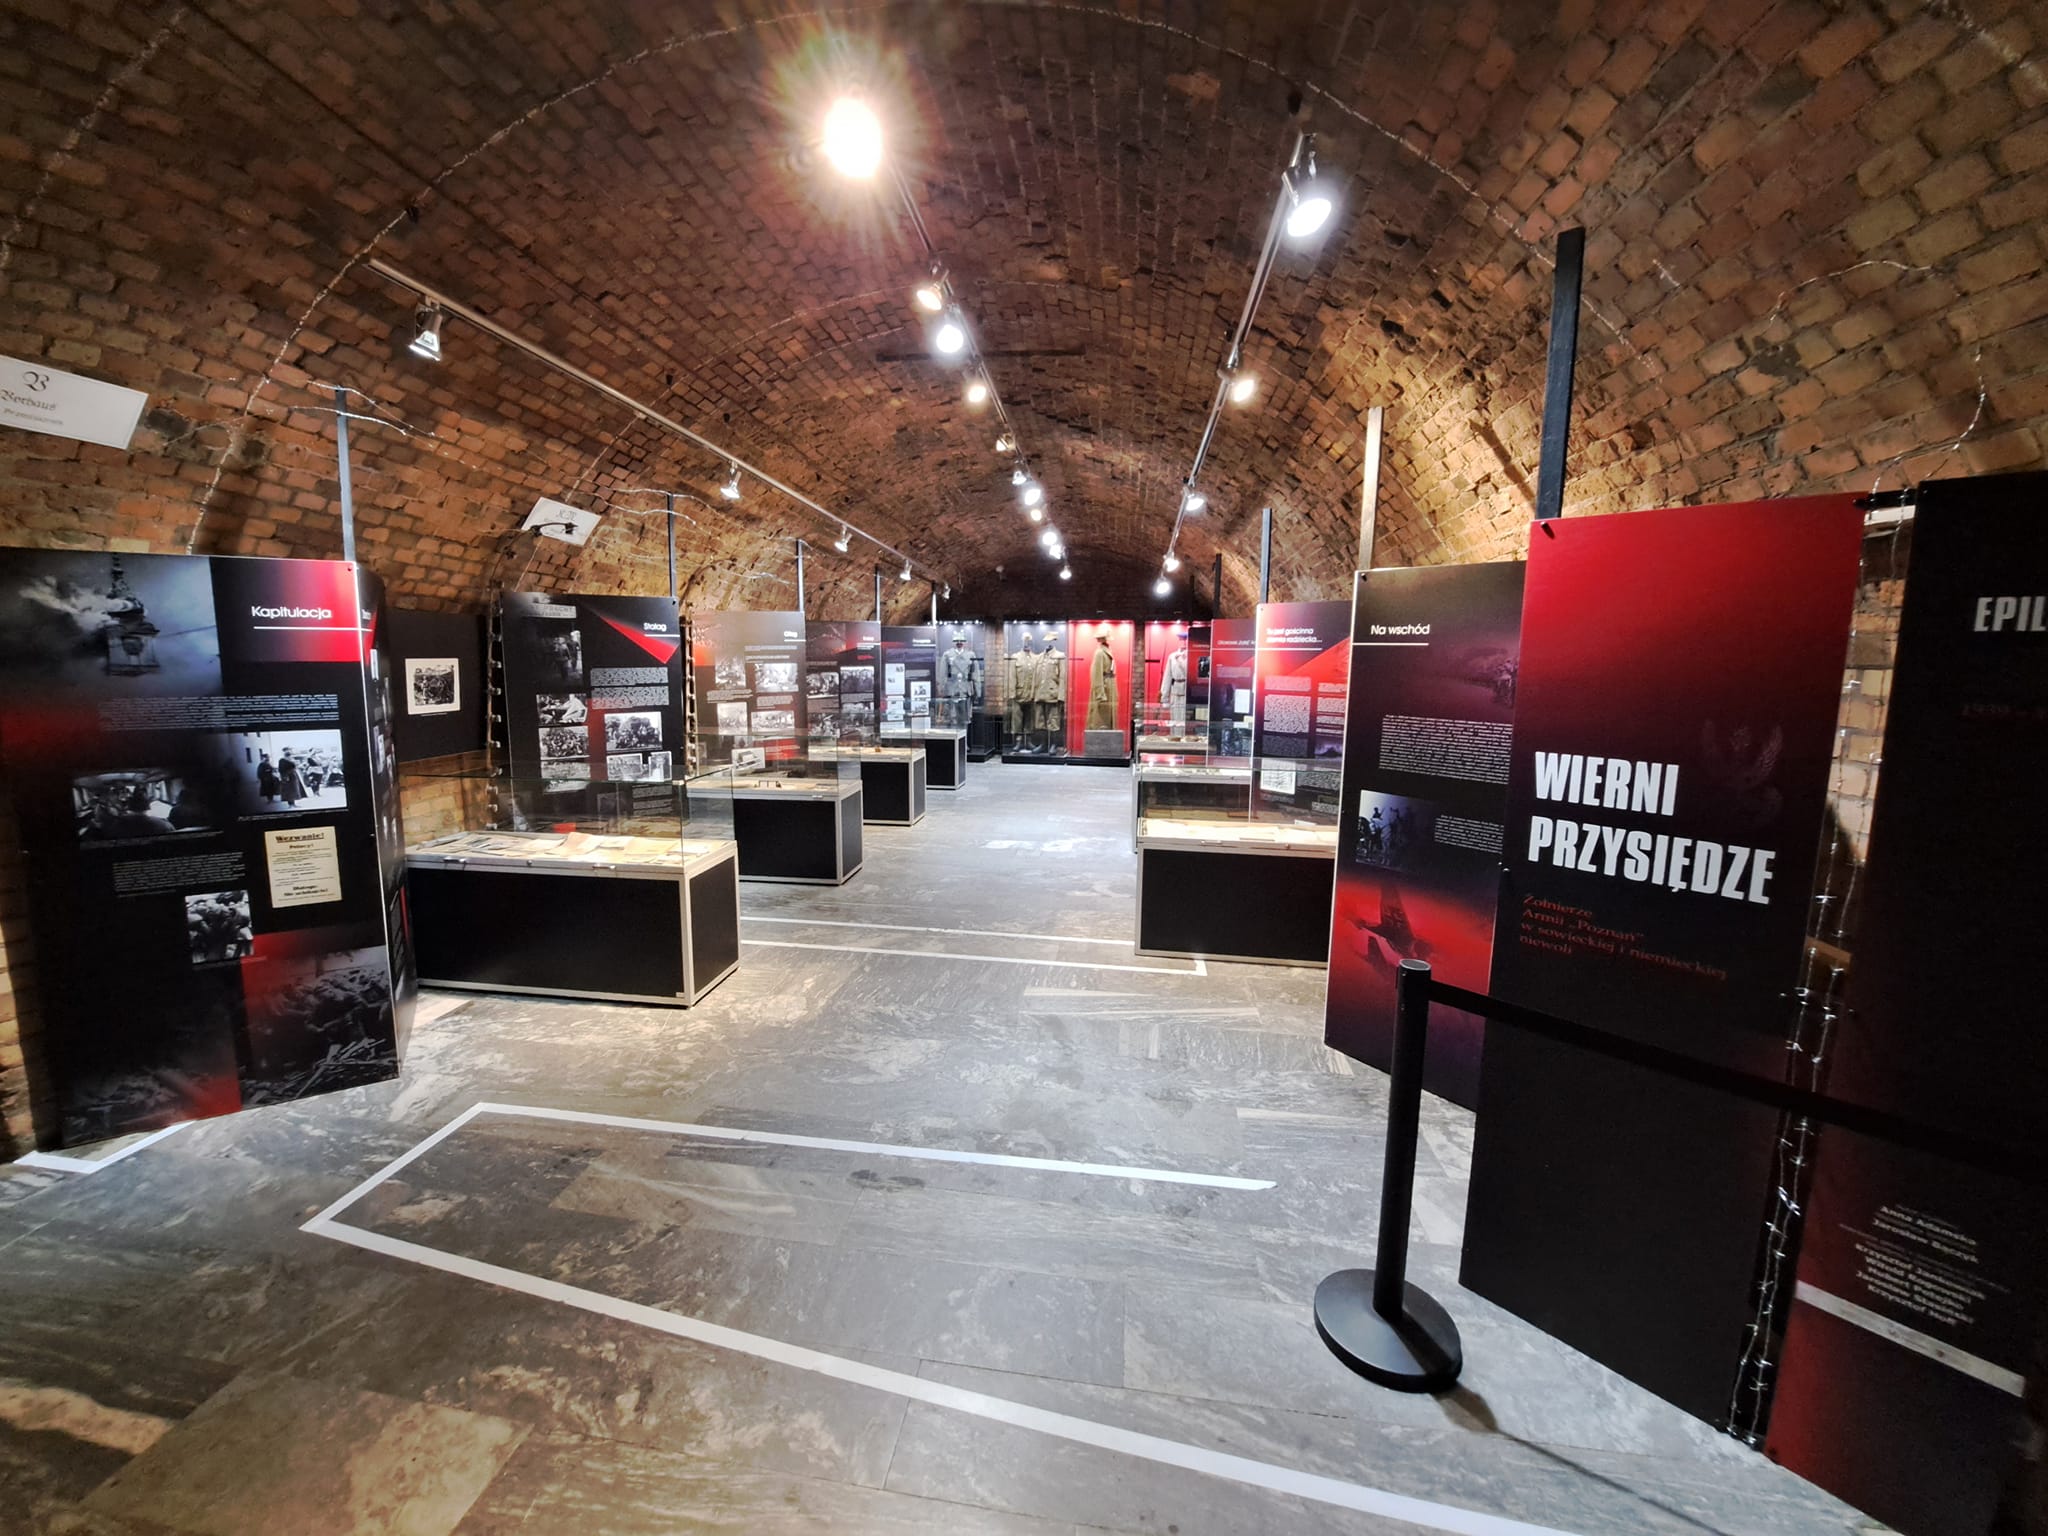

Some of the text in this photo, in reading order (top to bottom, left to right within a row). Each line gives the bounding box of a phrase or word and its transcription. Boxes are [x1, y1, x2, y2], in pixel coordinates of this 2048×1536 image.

[251, 606, 333, 620] Kapitulacja
[1973, 596, 2048, 632] EPIL
[643, 622, 667, 632] Stalag
[1370, 623, 1430, 636] Na wschód
[1535, 751, 1680, 816] WIERNI
[1527, 815, 1776, 905] PRZYSIĘDZE
[1521, 908, 1564, 927] Armii
[1519, 935, 1572, 955] niewoli
[1520, 922, 1532, 932] w
[1537, 925, 1615, 955] sowieckiej
[1629, 947, 1728, 981] niemieckiej
[1879, 1205, 1913, 1222] Anna
